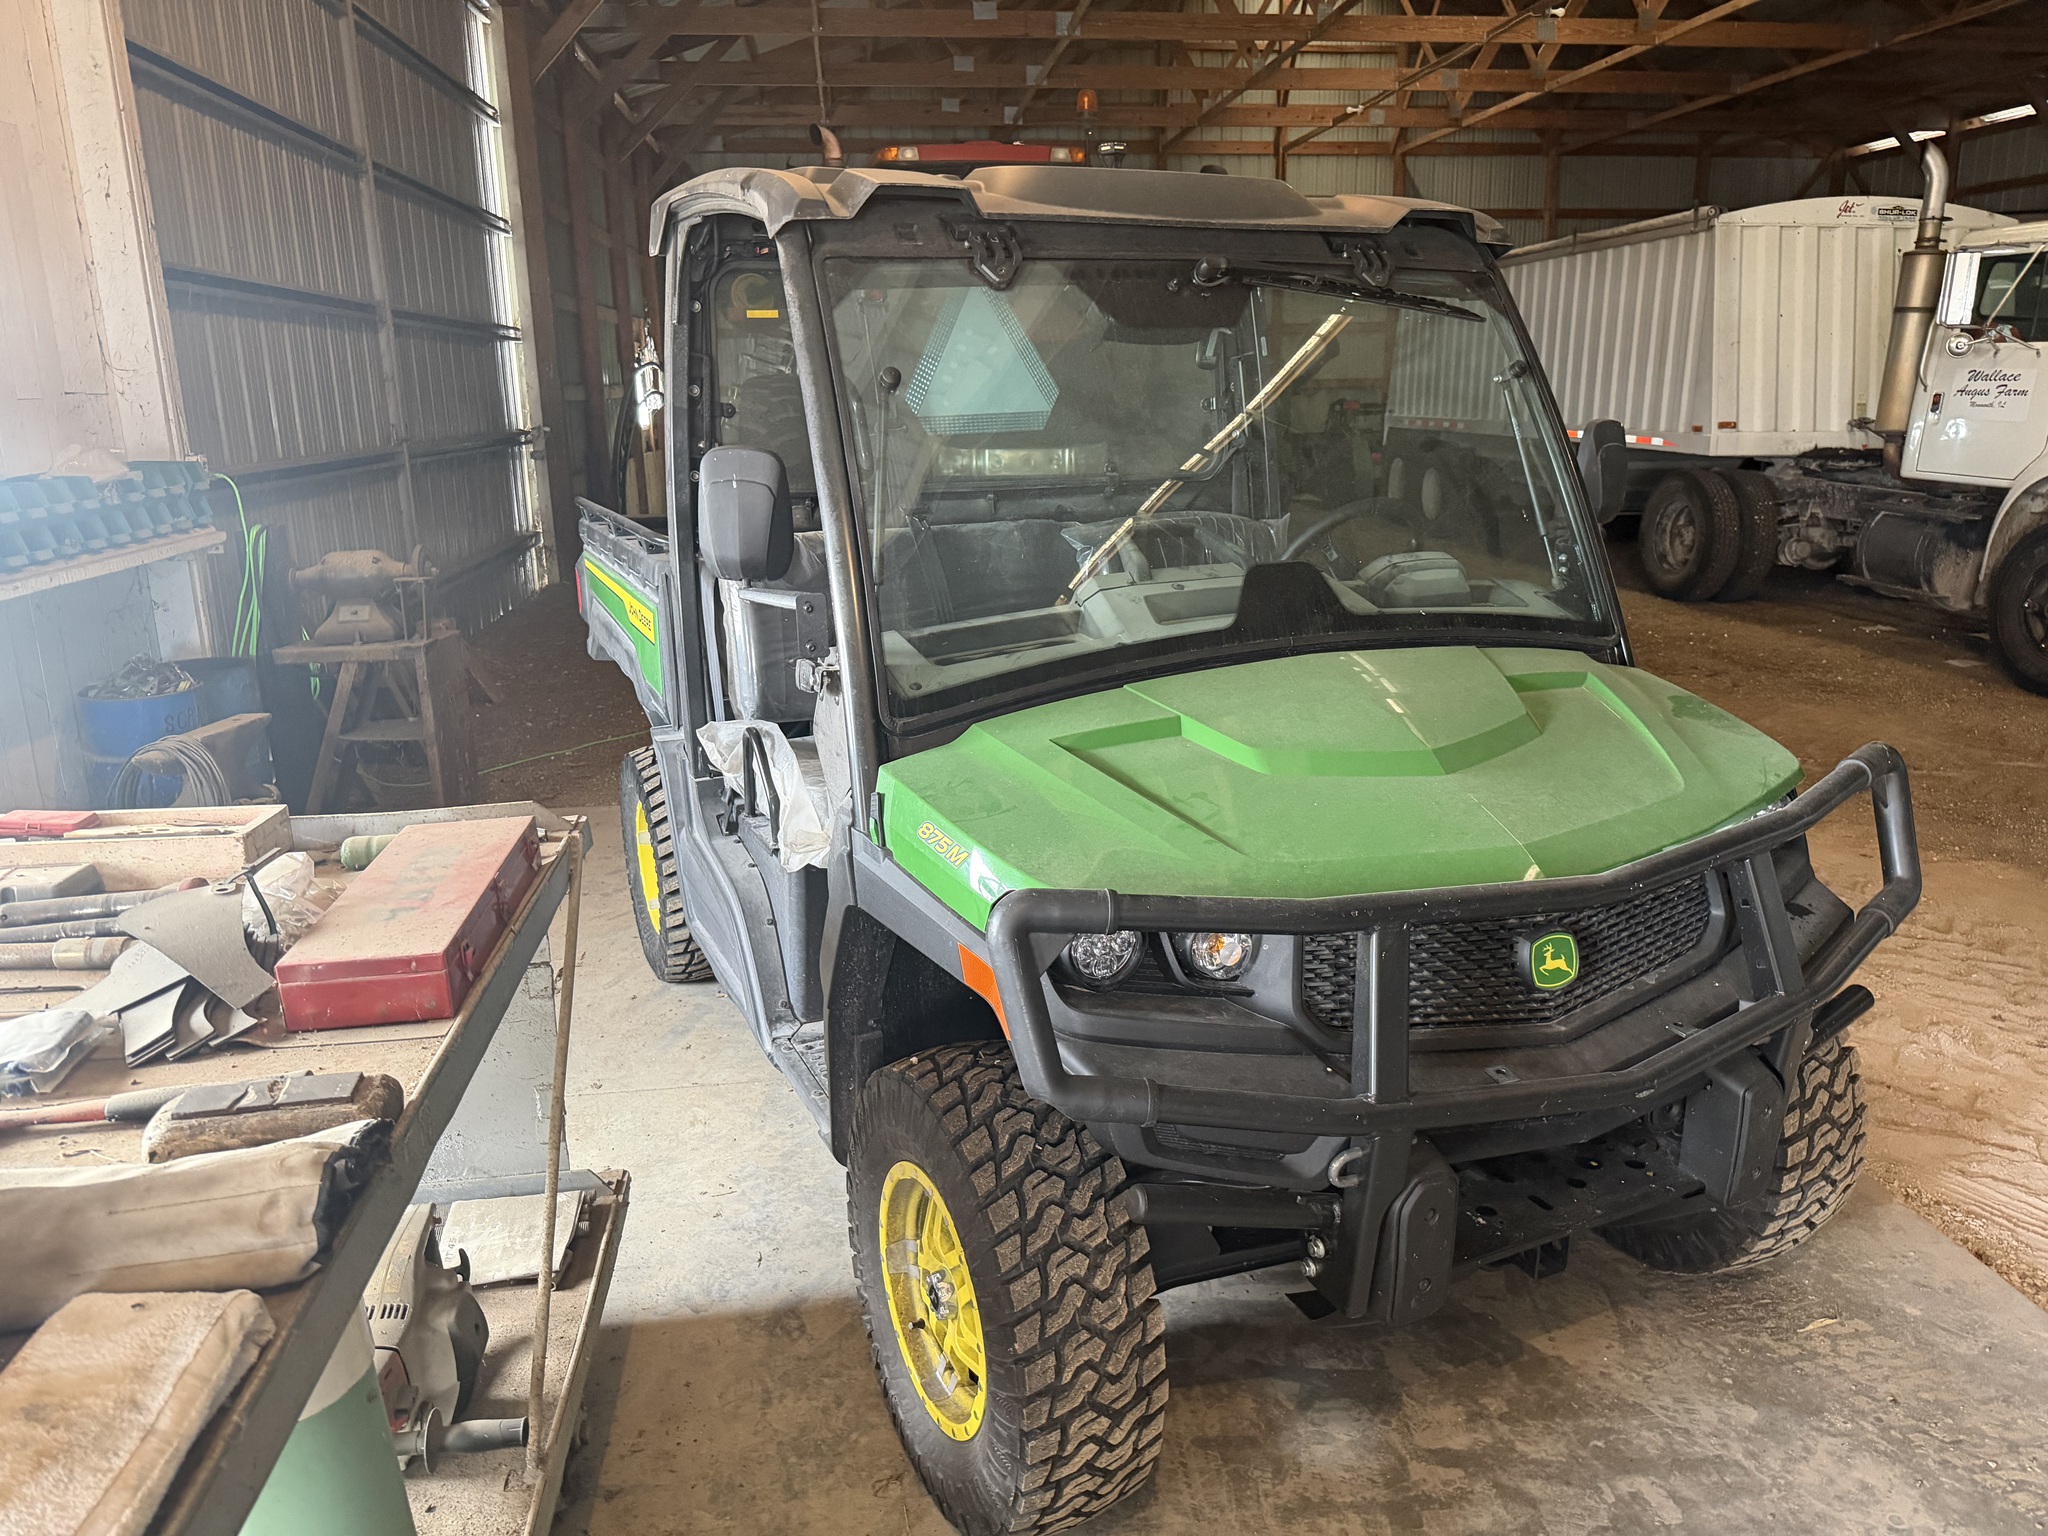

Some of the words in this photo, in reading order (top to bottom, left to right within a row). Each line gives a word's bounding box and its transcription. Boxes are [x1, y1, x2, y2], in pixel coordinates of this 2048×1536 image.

[1968, 369, 2021, 382] Wallace
[1953, 384, 1990, 400] Angus
[1994, 384, 2029, 399] Farm
[918, 822, 970, 868] 875M
